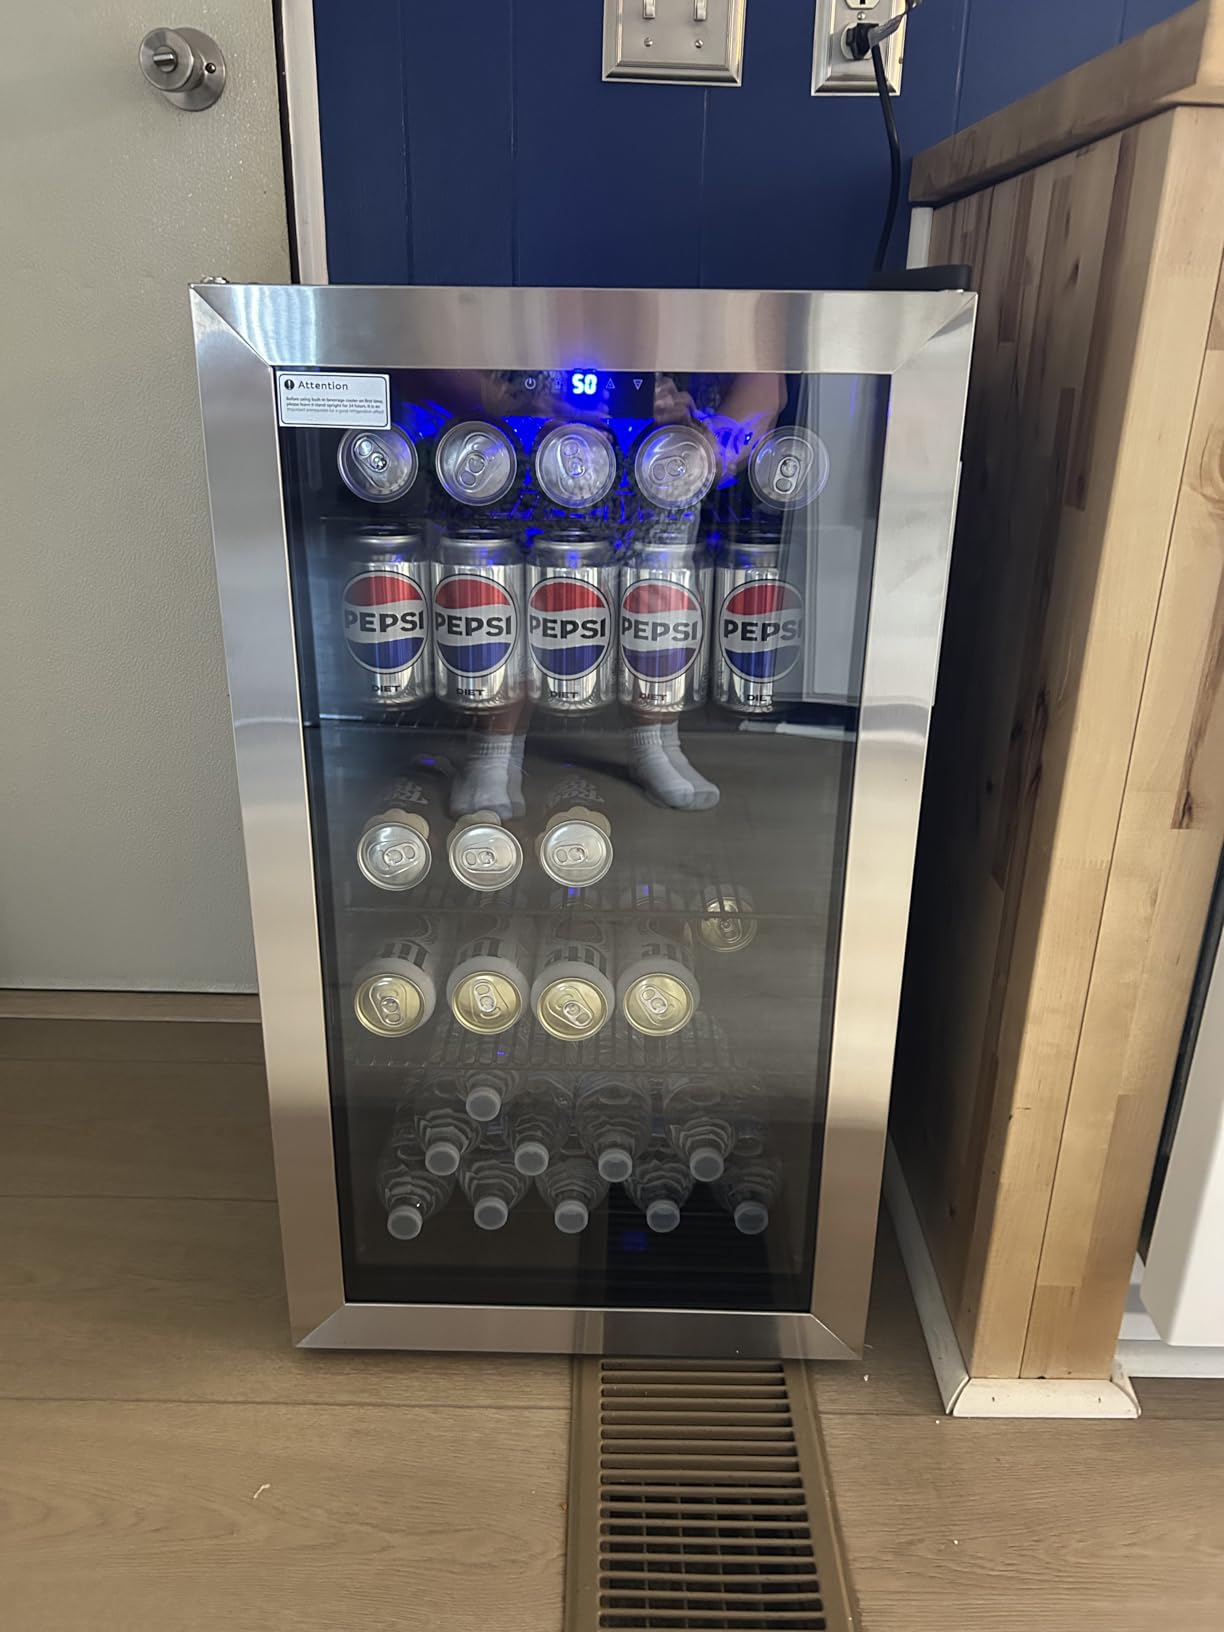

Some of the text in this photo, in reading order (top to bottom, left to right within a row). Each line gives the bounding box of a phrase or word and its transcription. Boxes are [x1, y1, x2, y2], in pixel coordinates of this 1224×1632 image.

[298, 380, 349, 391] Attention
[571, 373, 598, 395] 50
[344, 610, 424, 633] PEPSI
[435, 611, 512, 637] PEPSI
[529, 614, 606, 640] PEPSI
[621, 615, 698, 642] PEPSI
[723, 618, 802, 642] PEPSI
[371, 684, 401, 693] DIET
[456, 687, 486, 696] DIET
[550, 690, 579, 699] DIET
[639, 692, 668, 701] DIET
